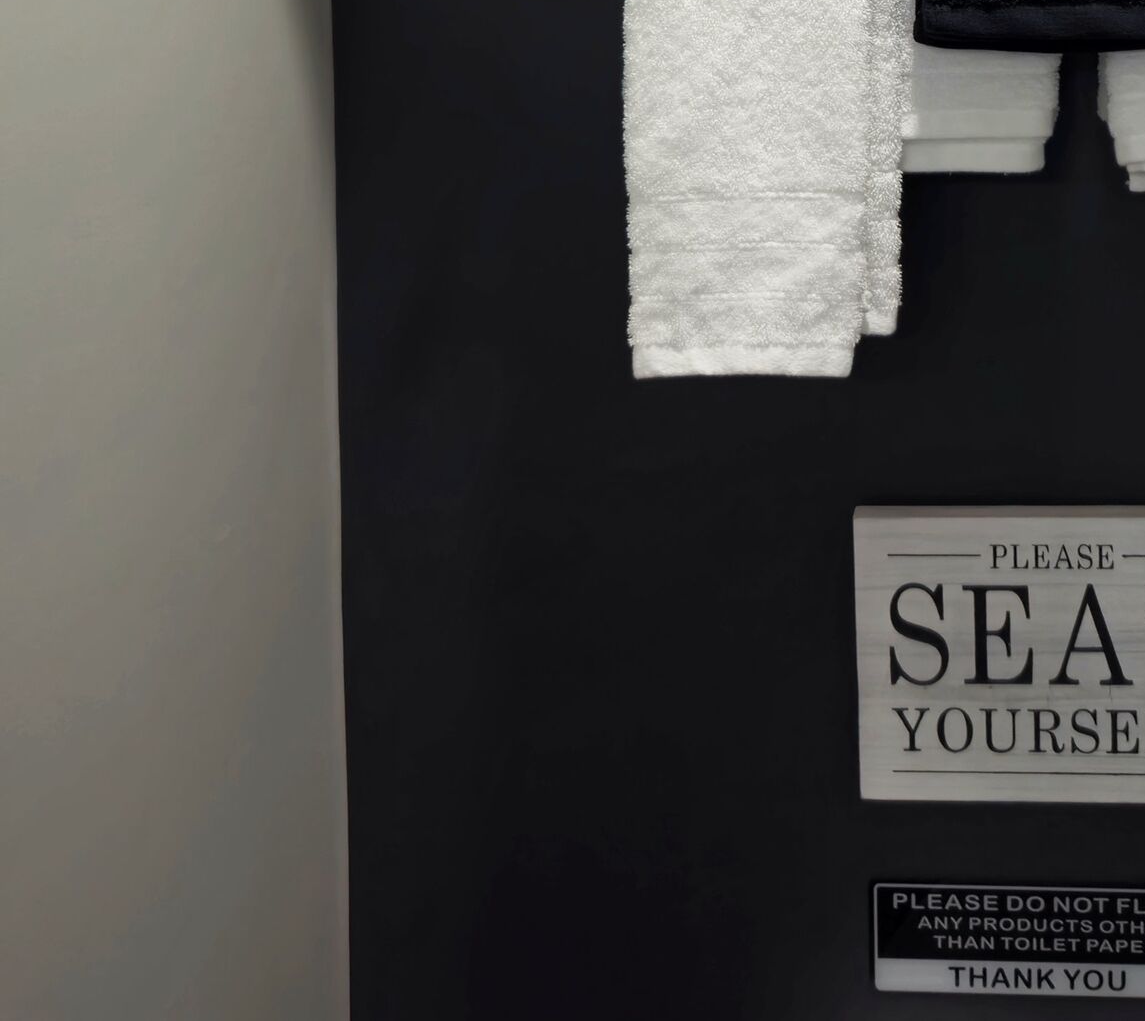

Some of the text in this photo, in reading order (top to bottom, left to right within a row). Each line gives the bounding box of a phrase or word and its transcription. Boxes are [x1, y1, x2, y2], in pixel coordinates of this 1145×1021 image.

[989, 543, 1115, 570] PLEASE
[892, 892, 999, 911] PLEASE
[1006, 895, 1046, 913] DO
[1053, 896, 1109, 914] NOT
[917, 916, 963, 930] ANY
[968, 917, 1093, 933] PRODUCTS
[933, 935, 995, 950] THAN
[1000, 936, 1081, 952] TOILET
[948, 966, 1127, 991] THANK YOU
